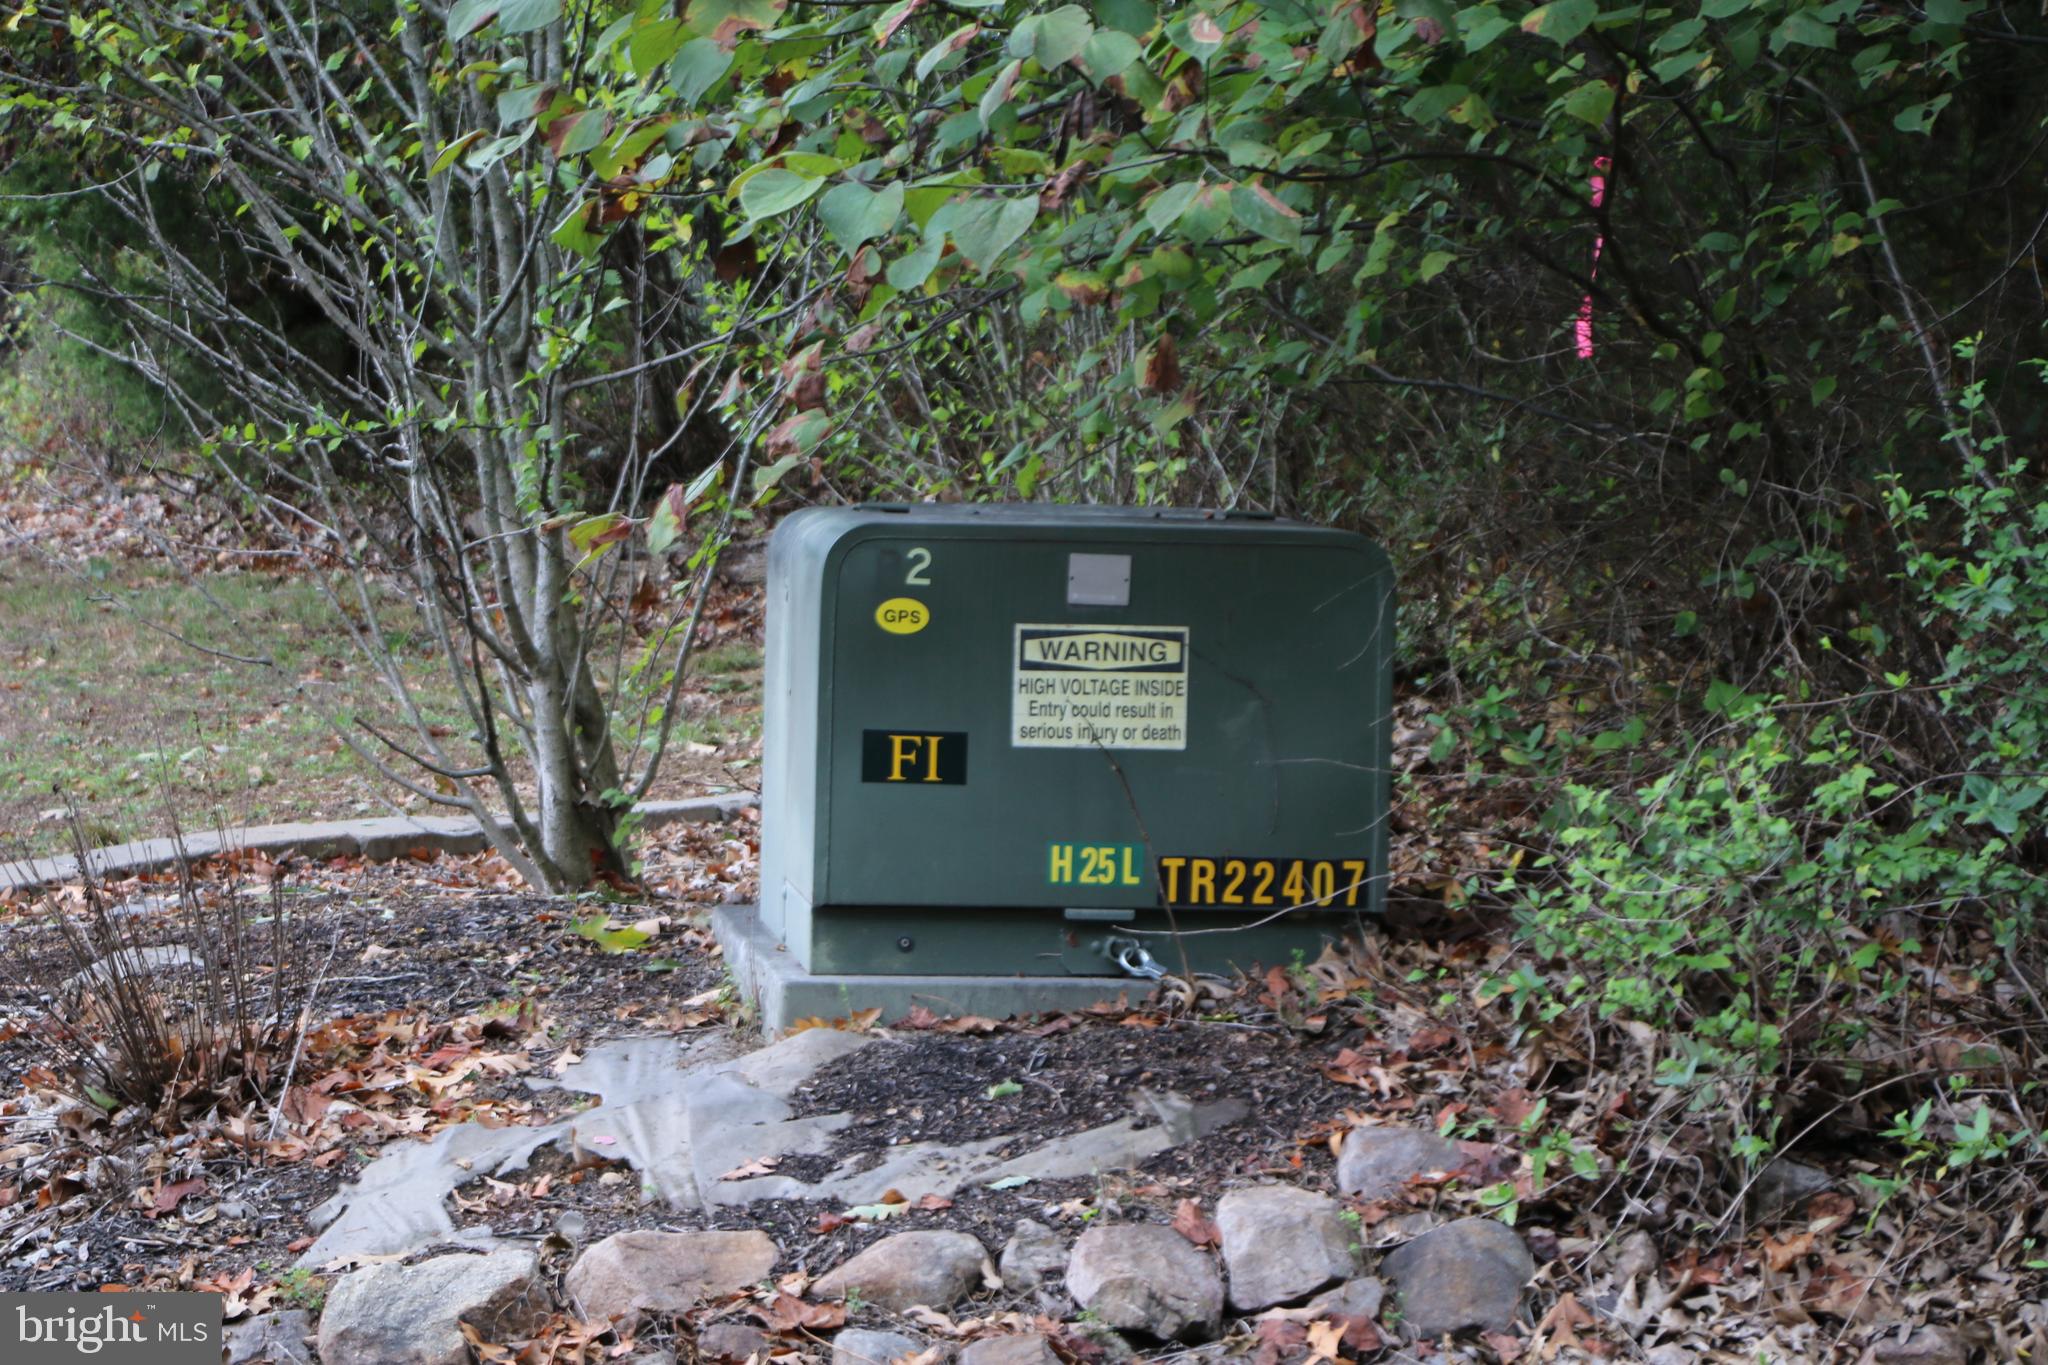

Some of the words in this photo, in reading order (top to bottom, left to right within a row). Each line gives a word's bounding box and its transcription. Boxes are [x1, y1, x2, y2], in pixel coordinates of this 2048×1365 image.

[905, 547, 932, 585] 2
[884, 609, 921, 624] GPS
[1039, 640, 1167, 662] WARNING
[1018, 678, 1056, 695] HIGH
[1060, 678, 1130, 696] VOLTAGE
[1136, 679, 1184, 697] INSIDE
[1029, 700, 1067, 721] Entry
[1072, 702, 1111, 718] could
[1116, 702, 1156, 719] result
[1161, 703, 1173, 718] in
[1020, 723, 1073, 740] serious
[1078, 723, 1118, 744] injury
[1122, 727, 1138, 740] or
[1141, 725, 1181, 741] death
[887, 734, 944, 782] FI
[1162, 857, 1365, 906] TR22407
